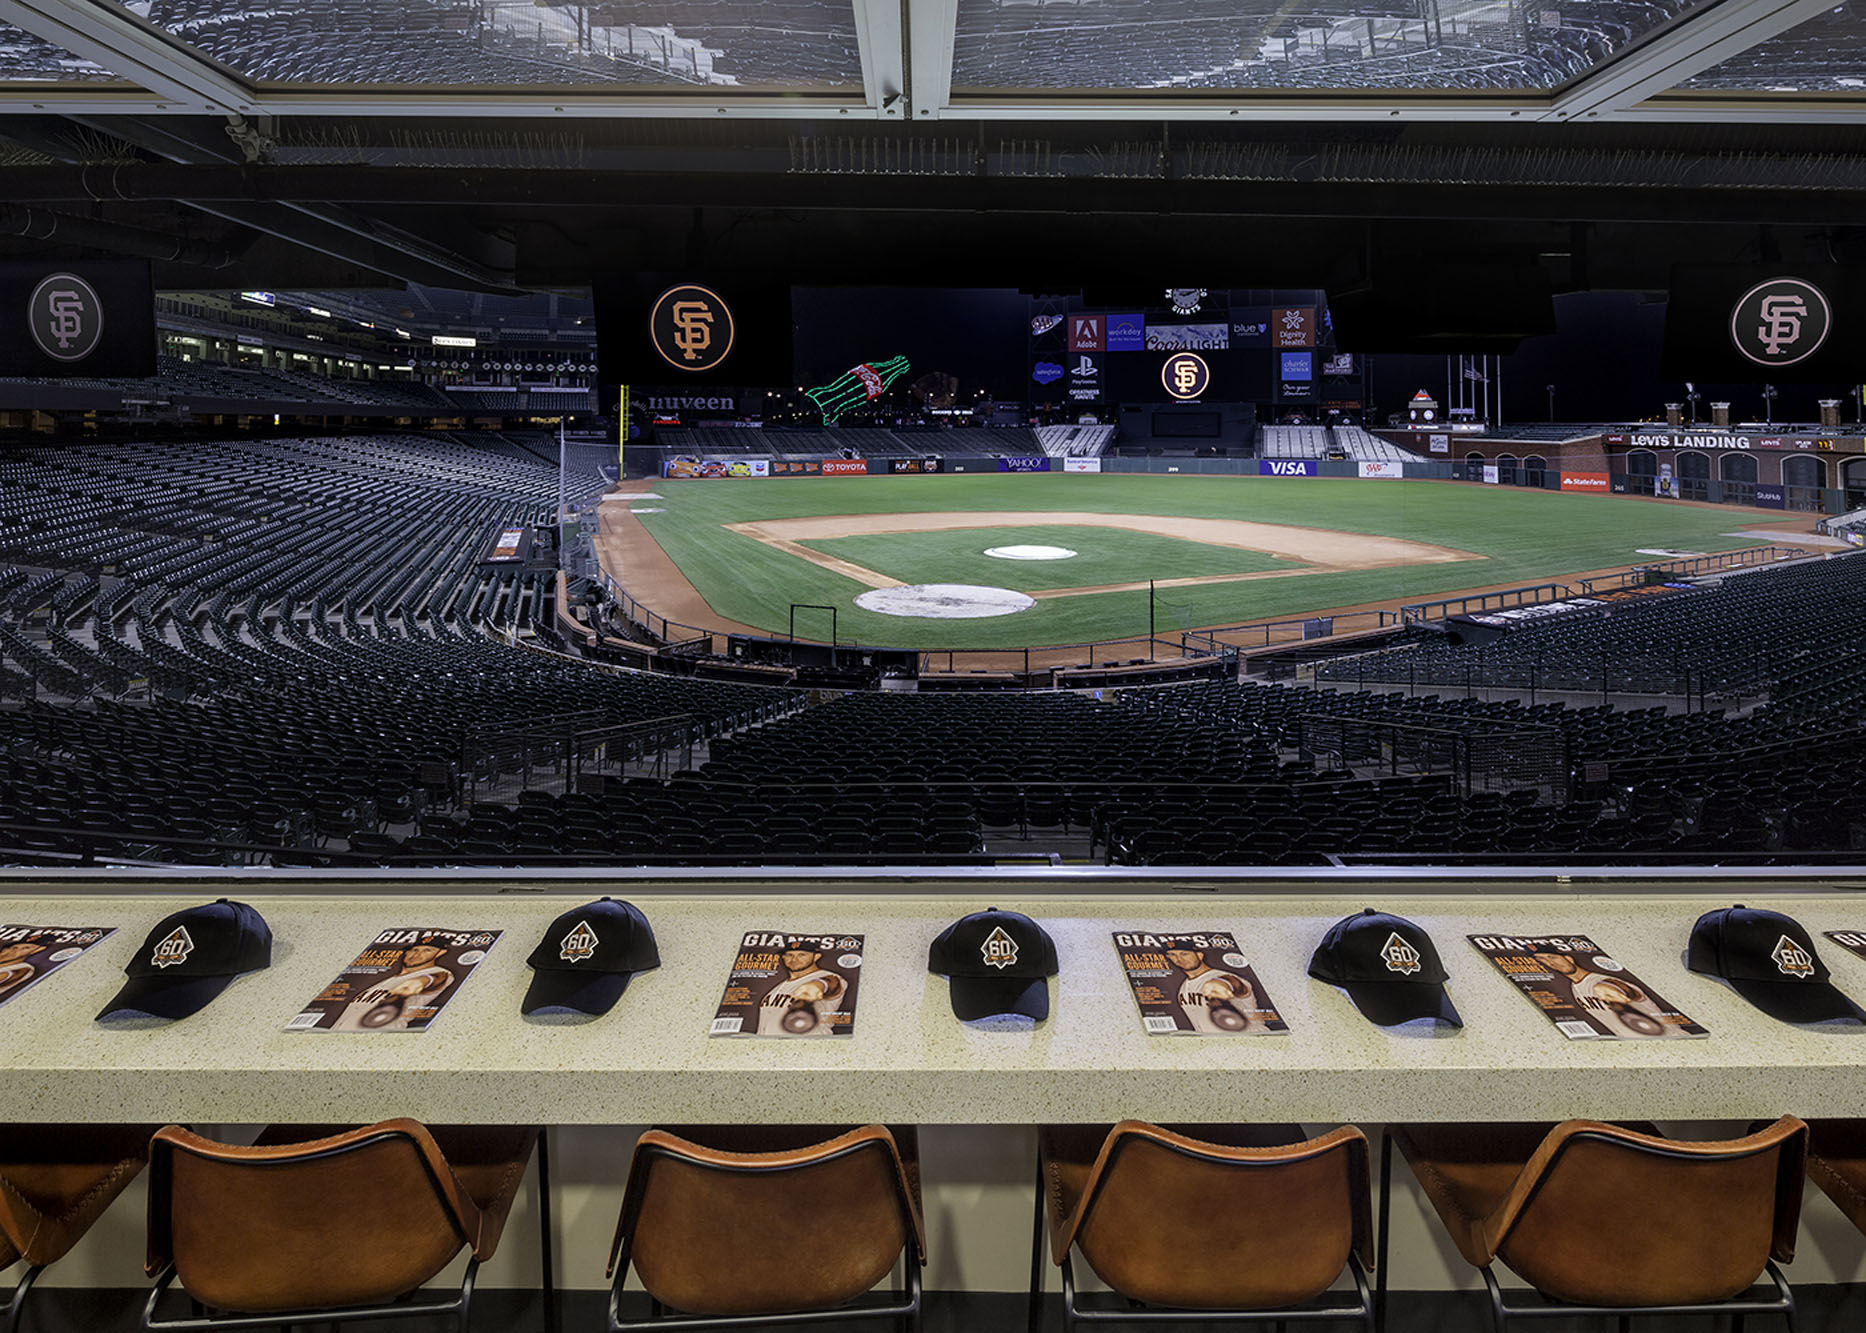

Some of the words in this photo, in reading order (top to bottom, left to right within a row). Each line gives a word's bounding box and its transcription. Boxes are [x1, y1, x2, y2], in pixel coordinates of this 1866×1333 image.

[1171, 304, 1201, 315] GIANTS
[49, 291, 84, 348] SF
[1758, 295, 1807, 354] SF
[672, 301, 714, 359] SF
[1233, 323, 1257, 333] blue
[1280, 331, 1307, 340] Dignity
[1076, 340, 1097, 348] Adobe
[1145, 336, 1188, 351] Coors
[1189, 339, 1229, 350] LIGHT
[1036, 368, 1061, 376] salesforce
[1174, 360, 1198, 393] SF
[648, 396, 735, 410] nuveen
[1673, 435, 1750, 449] LANDING
[835, 463, 866, 472] TOYOTA
[1267, 461, 1306, 475] VISA
[1756, 492, 1782, 501] StubHub
[160, 939, 186, 956] 60
[567, 933, 591, 950] 60
[988, 939, 1010, 957] 60
[1389, 945, 1413, 963] 60
[360, 949, 405, 960] ALL-STAR
[737, 953, 781, 962] ALL-STAR
[1124, 953, 1167, 962] ALL-STAR
[1780, 949, 1807, 966] 60
[735, 961, 780, 970] GOURMET
[1126, 961, 1172, 970] GOURMET
[1494, 956, 1541, 967] ALL-STAR
